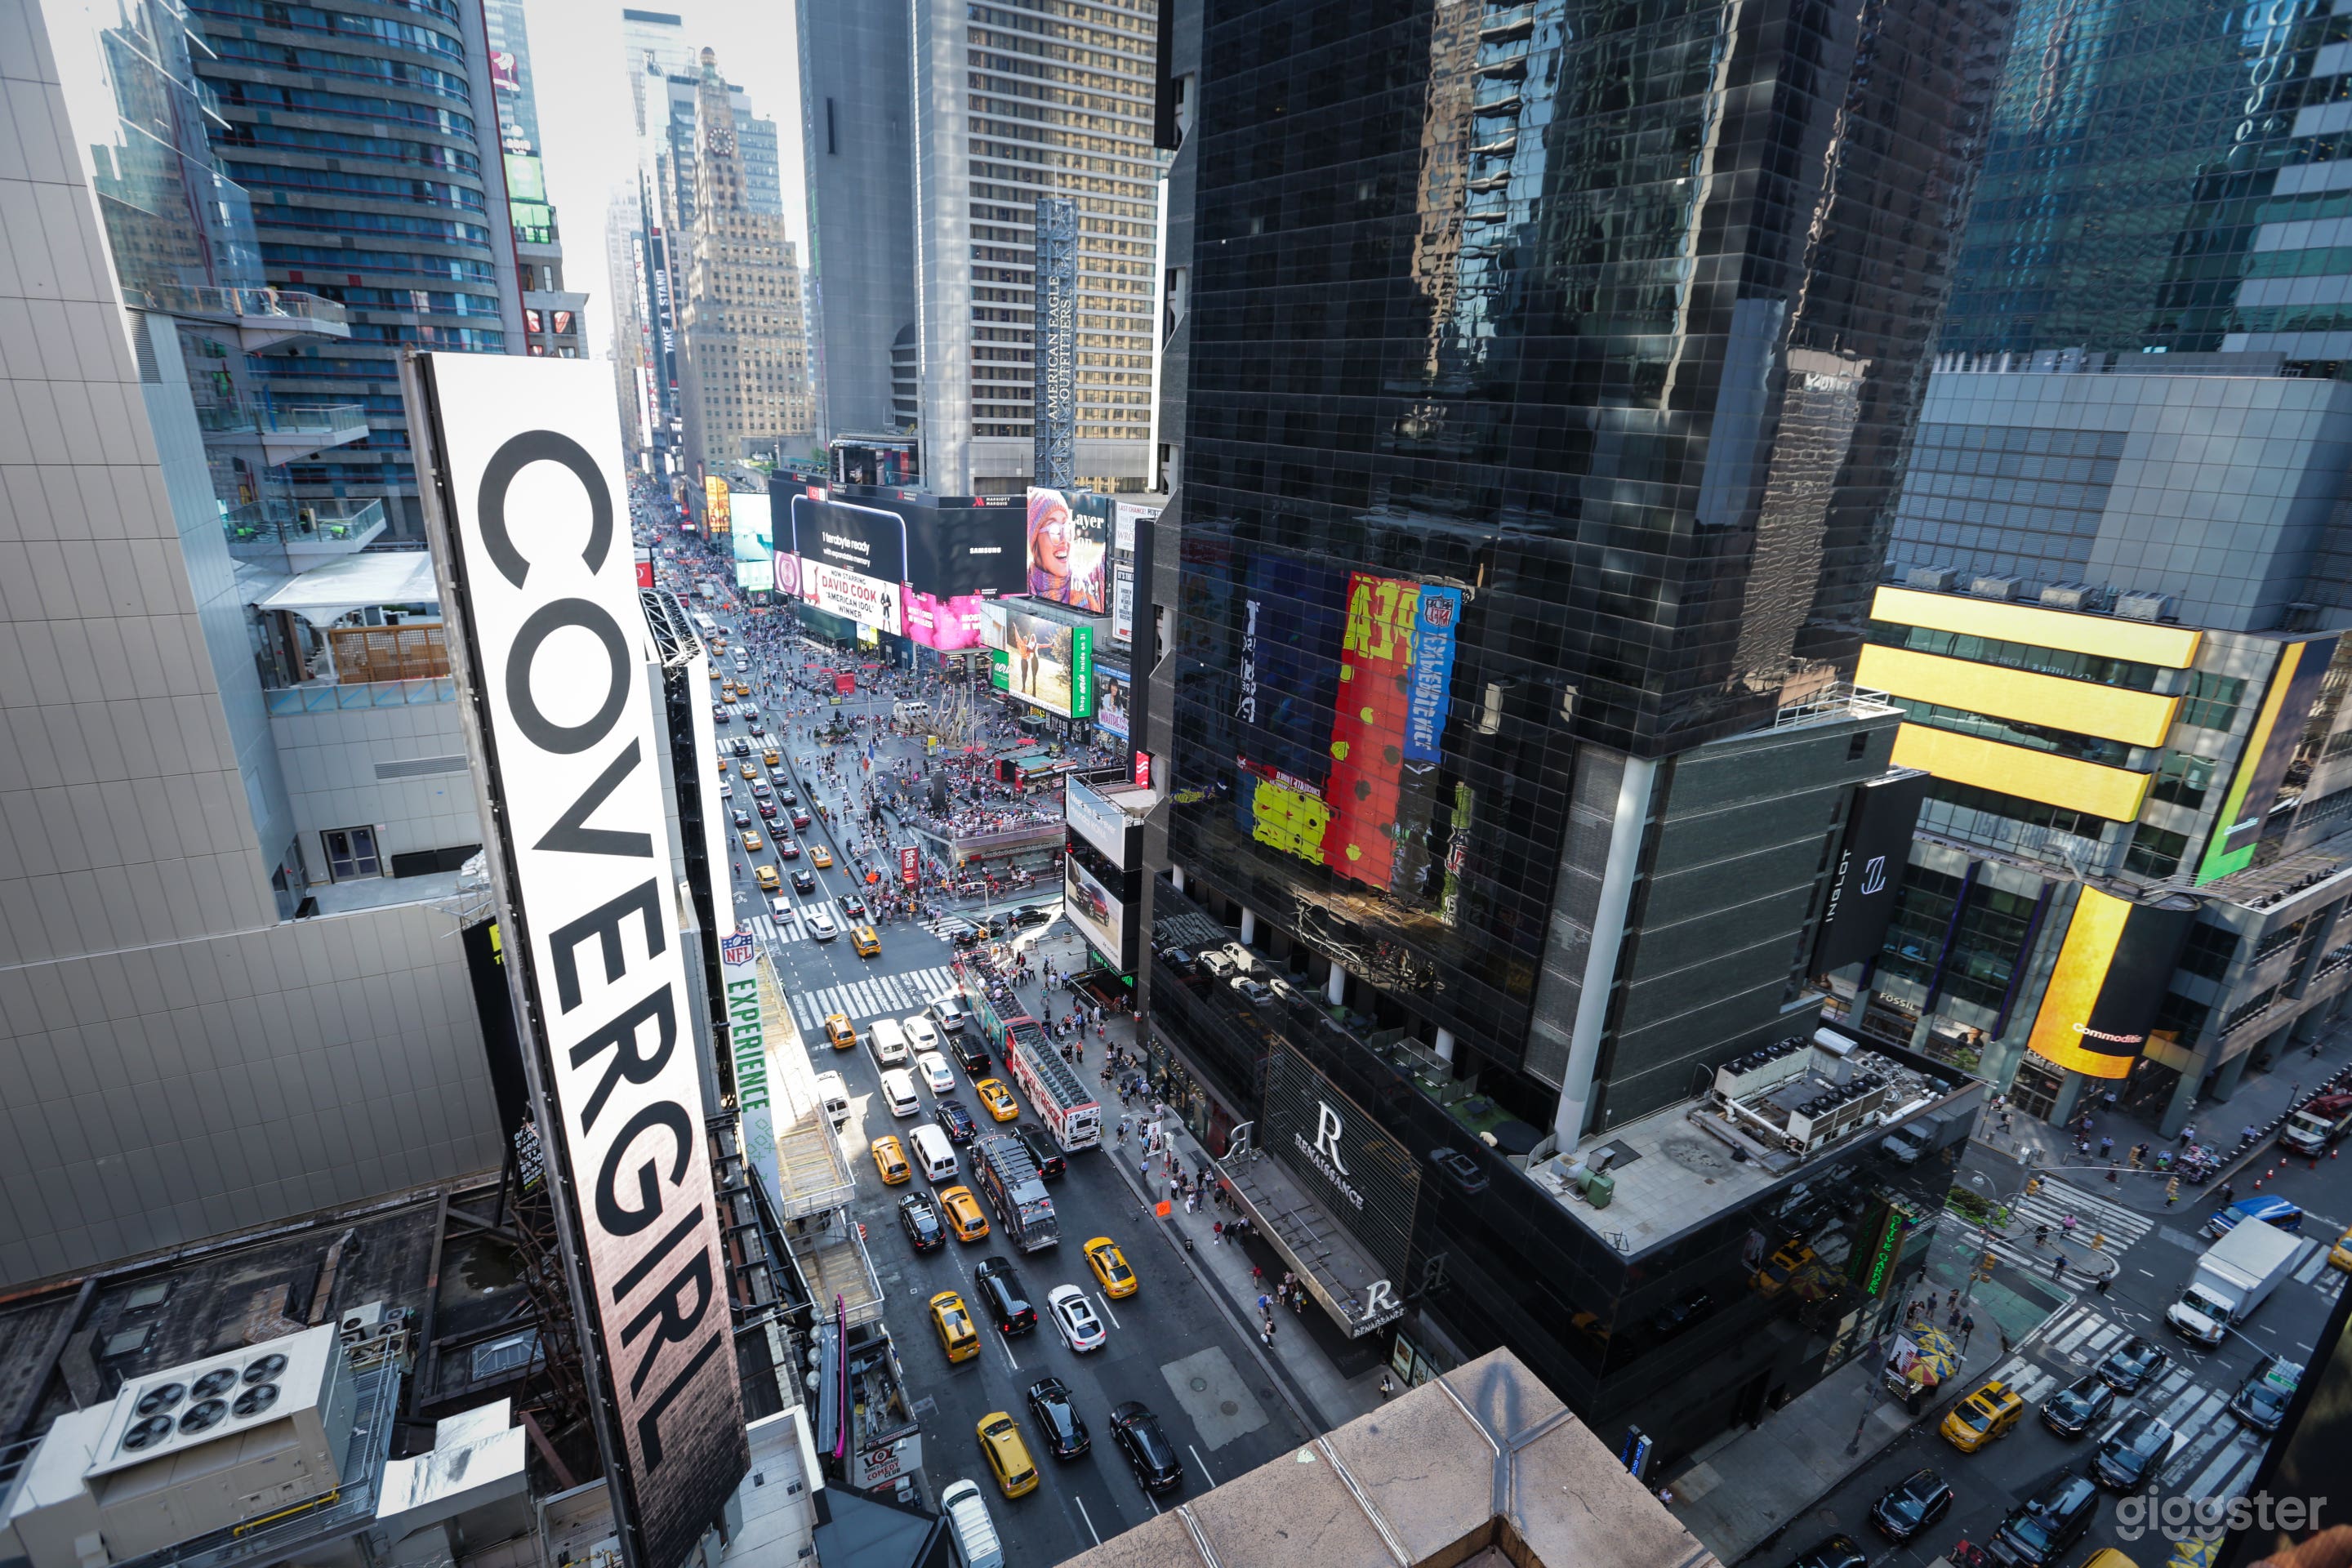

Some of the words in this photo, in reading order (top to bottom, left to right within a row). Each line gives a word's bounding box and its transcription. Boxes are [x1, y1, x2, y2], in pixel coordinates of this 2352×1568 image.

[656, 270, 669, 306] STAND
[1049, 276, 1059, 327] EAGLE
[662, 327, 675, 353] TAKE
[1059, 300, 1071, 399] OUTFITTERS
[1048, 332, 1058, 421] AMERICAN
[1069, 509, 1105, 530] Layer
[826, 532, 851, 549] terabyte
[851, 539, 871, 555] ready
[1117, 530, 1134, 542] WRO
[822, 576, 849, 595] DAVID
[850, 583, 877, 604] COOK
[831, 569, 842, 578] NOW
[842, 572, 866, 585] STARRING
[838, 604, 862, 619] WINNER
[1080, 642, 1086, 651] on
[1100, 710, 1128, 731] WAITRESS
[1825, 849, 1852, 923] INGLOT
[478, 430, 722, 1476] COVERGIRL
[725, 946, 752, 964] NFL
[1879, 992, 1915, 1011] FOSSIL
[727, 978, 770, 1114] EXPERIENCE
[1014, 1053, 1036, 1094] SCHOOL
[1040, 1092, 1061, 1128] ROCK
[1314, 1100, 1350, 1176] R
[1294, 1132, 1365, 1210] RENAISSANCE
[1361, 1279, 1400, 1321] R
[1353, 1307, 1405, 1338] RENAISSANCE
[863, 1446, 897, 1468] LOL
[864, 1465, 880, 1474] TIMES
[880, 1456, 901, 1468] SQUARE
[866, 1462, 900, 1481] COMEDY
[884, 1468, 901, 1478] CLUB
